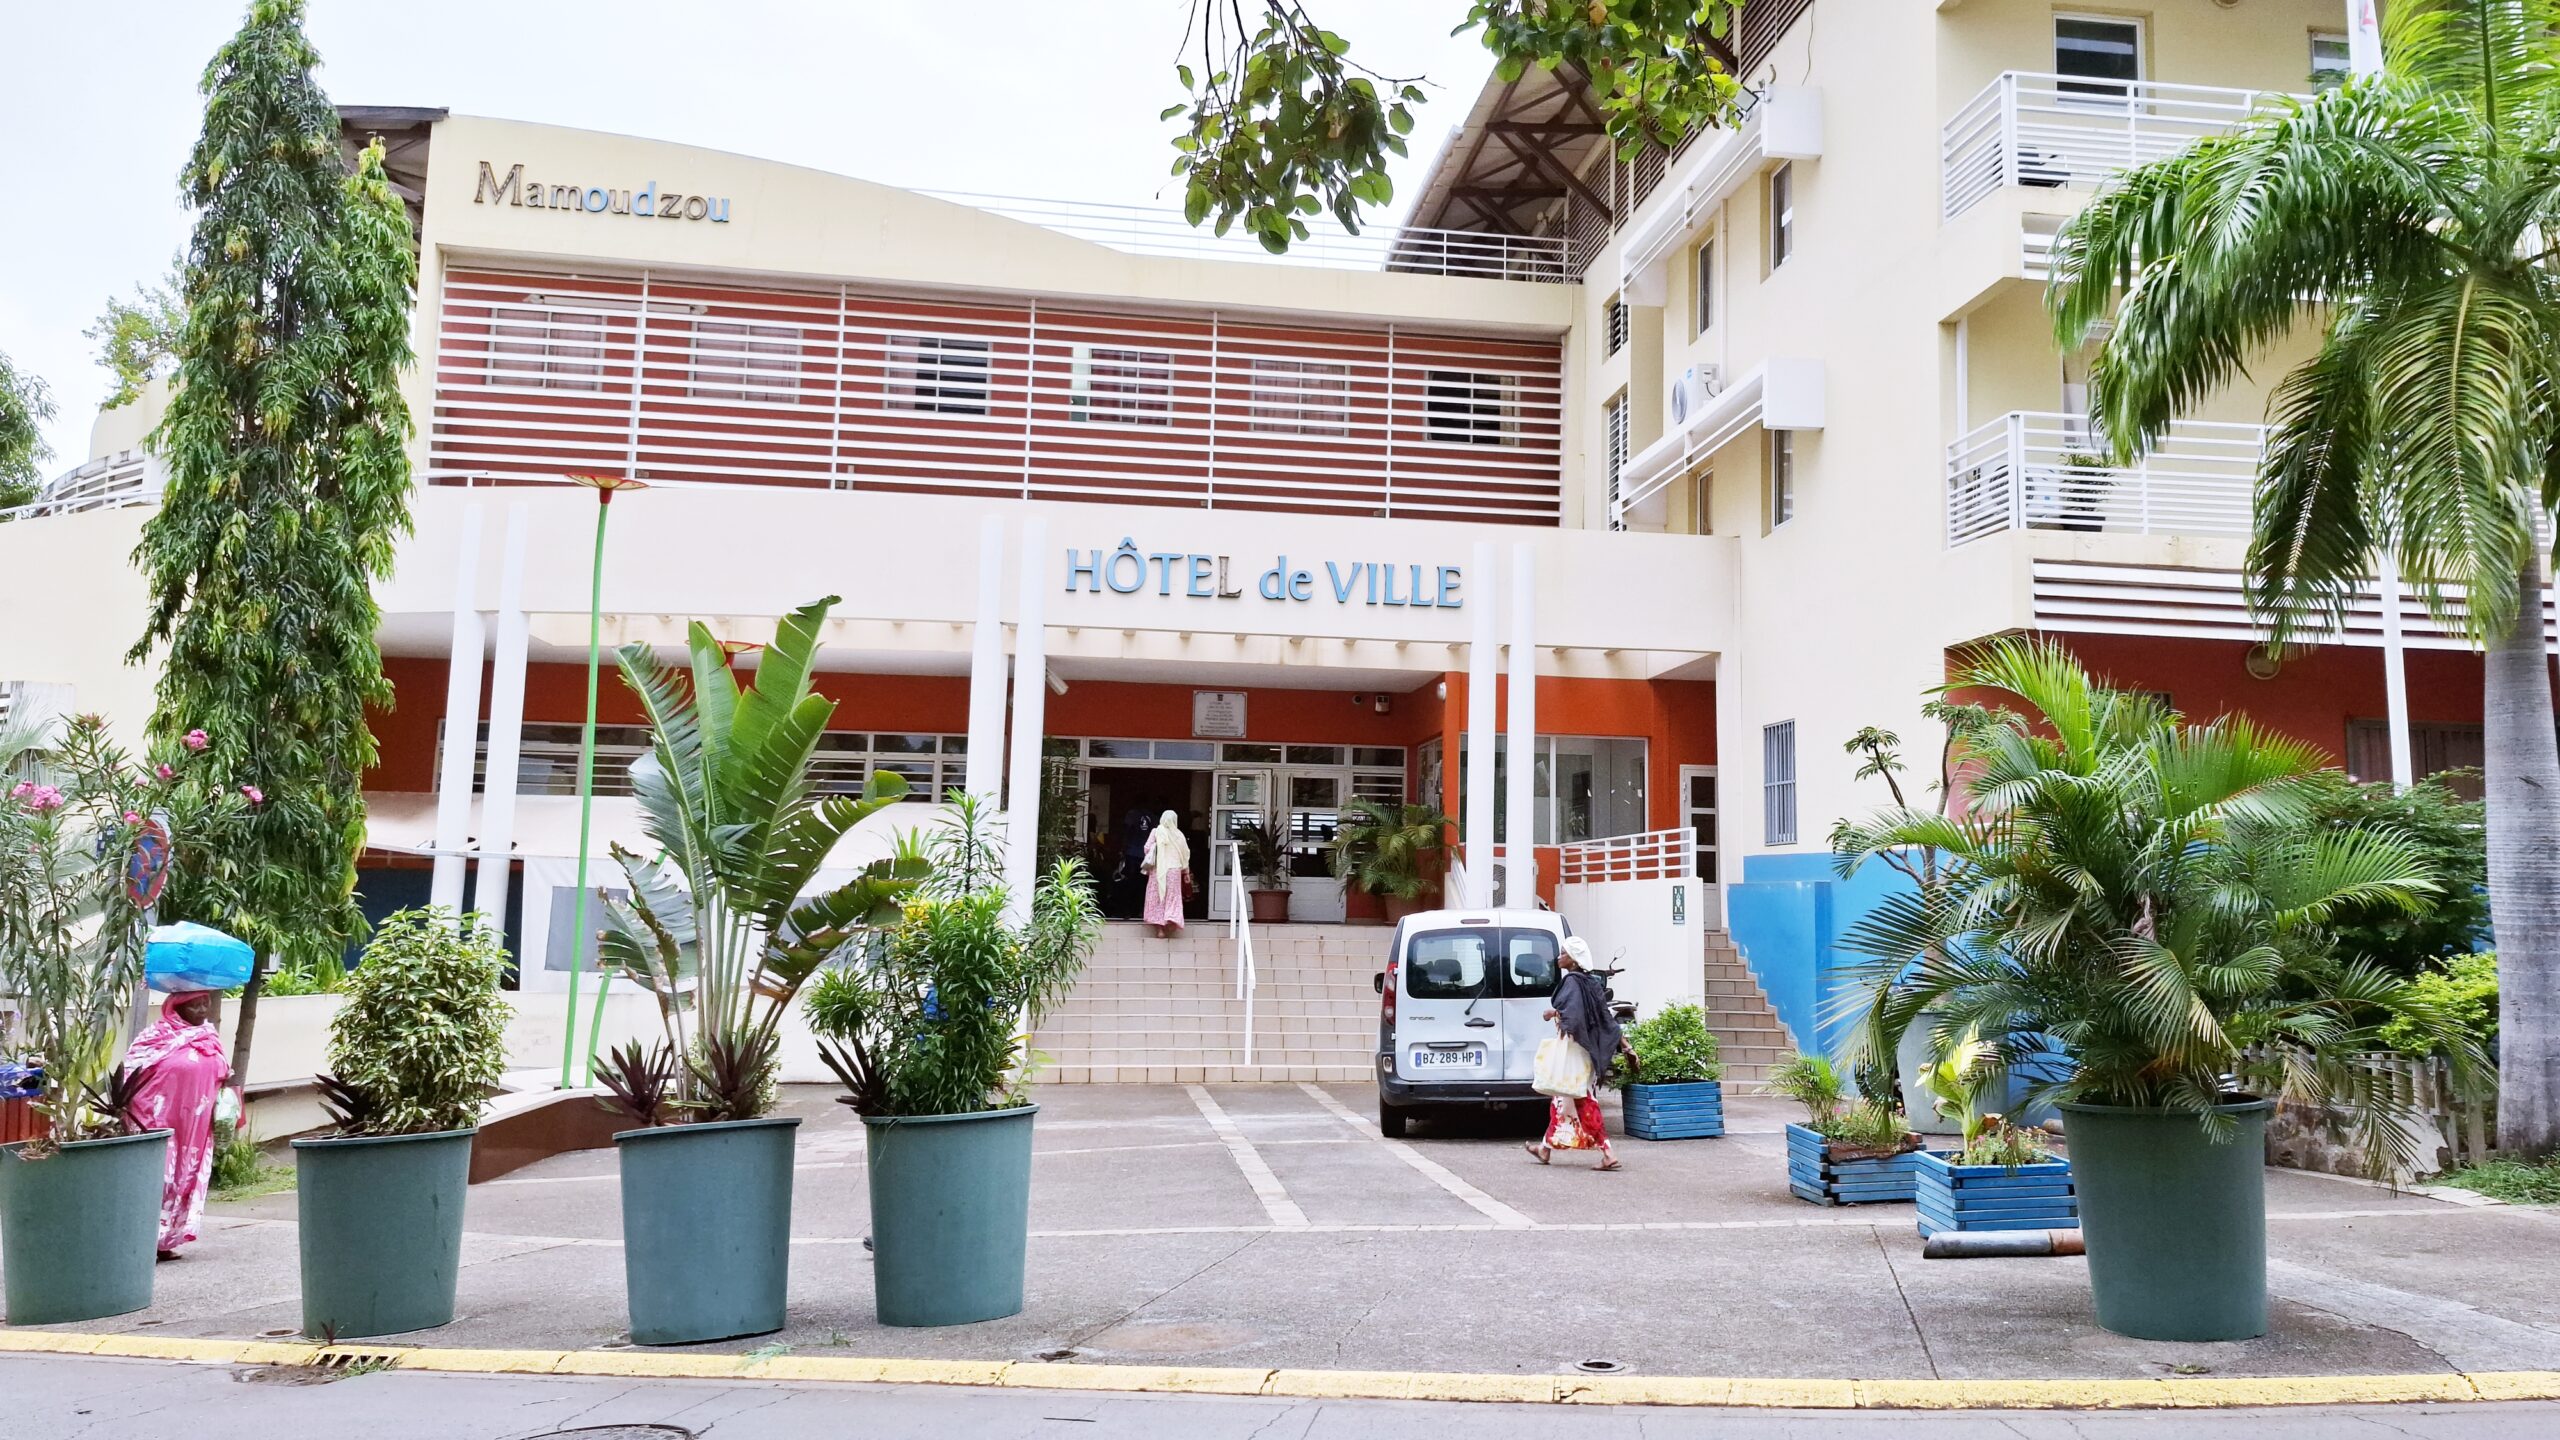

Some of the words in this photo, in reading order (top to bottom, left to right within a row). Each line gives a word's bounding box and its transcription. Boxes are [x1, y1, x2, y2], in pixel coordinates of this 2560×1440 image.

[474, 160, 730, 223] Mamoudzou
[1065, 536, 1242, 598] HÔTEL
[1259, 555, 1314, 601] de
[1325, 561, 1464, 608] VILLE
